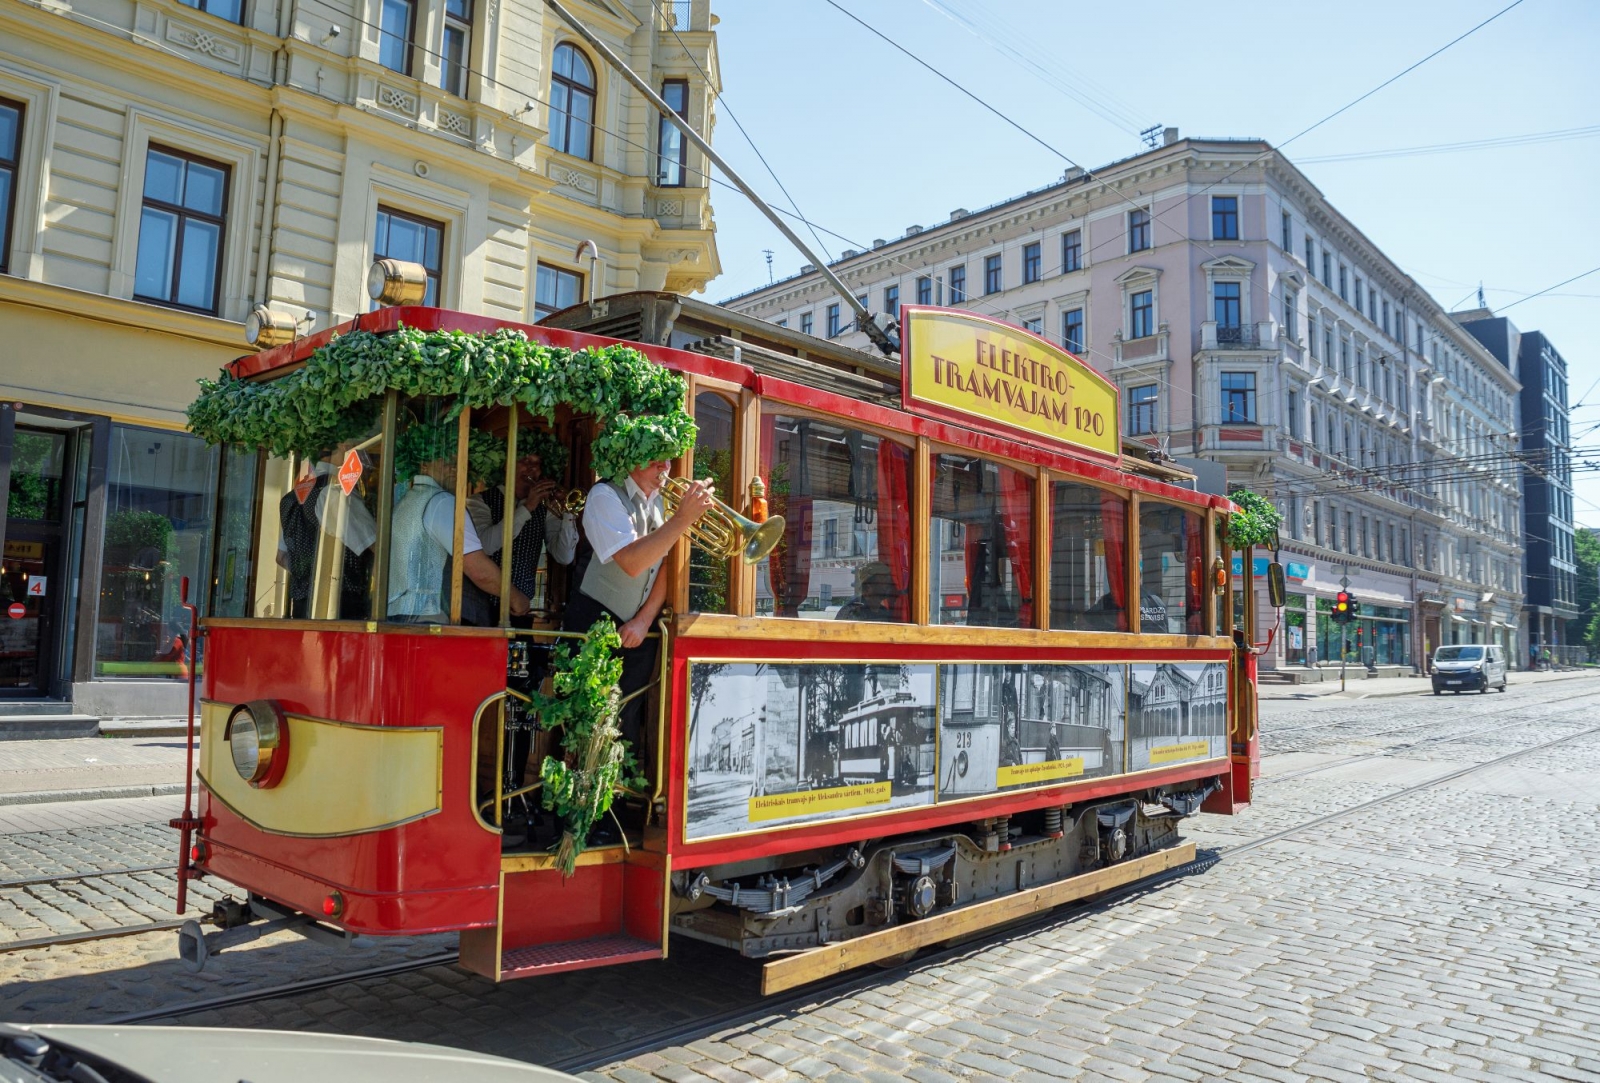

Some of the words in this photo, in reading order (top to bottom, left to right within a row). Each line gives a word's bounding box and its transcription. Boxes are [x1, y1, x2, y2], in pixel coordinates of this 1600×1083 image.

[976, 339, 1075, 396] ELEKTRO-
[930, 355, 1068, 425] TRAMVAJAM
[1074, 406, 1105, 437] 120
[30, 581, 42, 594] 4
[956, 731, 972, 748] 213
[755, 798, 786, 809] Elektriskais
[786, 795, 808, 805] tramvajs
